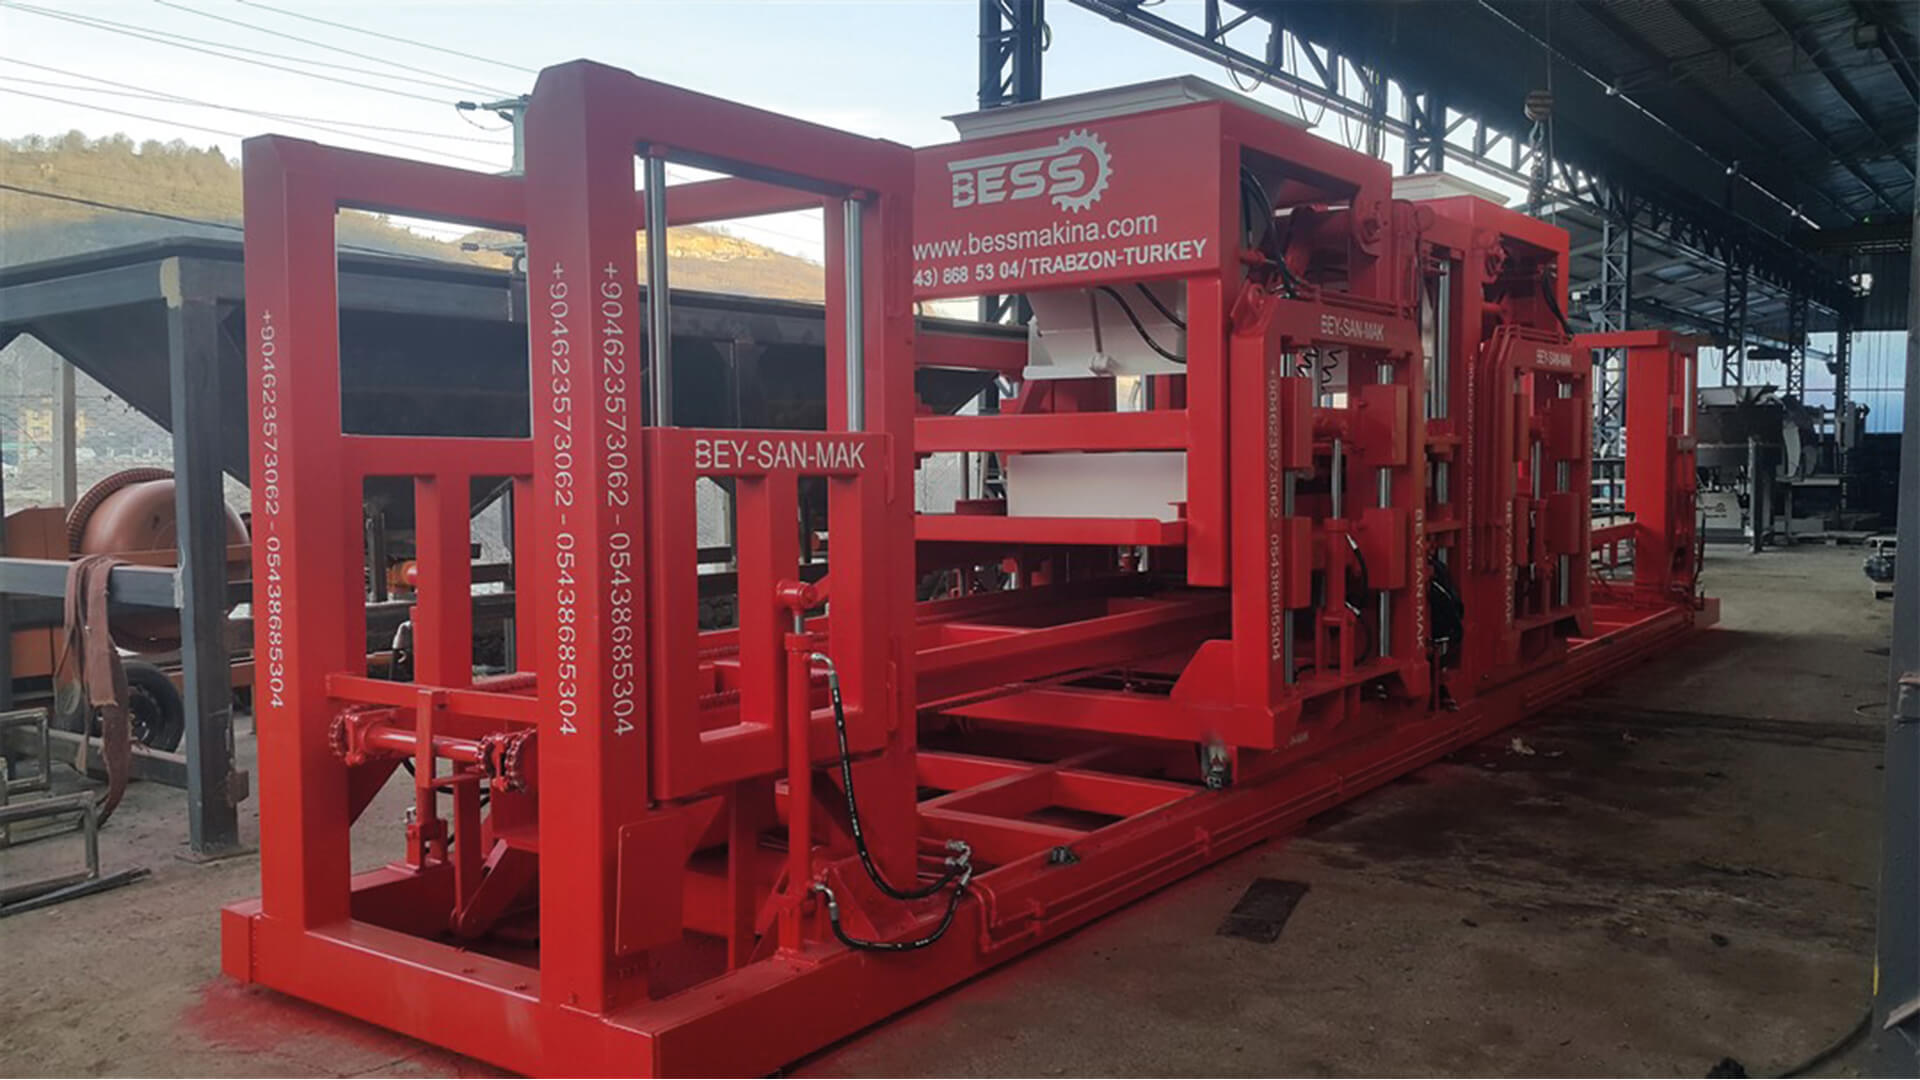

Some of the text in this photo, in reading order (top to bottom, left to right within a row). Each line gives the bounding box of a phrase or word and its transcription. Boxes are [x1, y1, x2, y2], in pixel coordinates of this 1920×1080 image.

[912, 214, 1158, 261] www.bessmakina.com
[952, 153, 1083, 208] BESS
[943, 265, 969, 285] 868
[976, 263, 995, 281] 53
[550, 261, 574, 507] +904623573062
[601, 261, 629, 507] +904623573062
[695, 439, 866, 469] BEY-SAN-MAK
[556, 532, 577, 736] 05438685304
[609, 532, 635, 736] 05438685304
